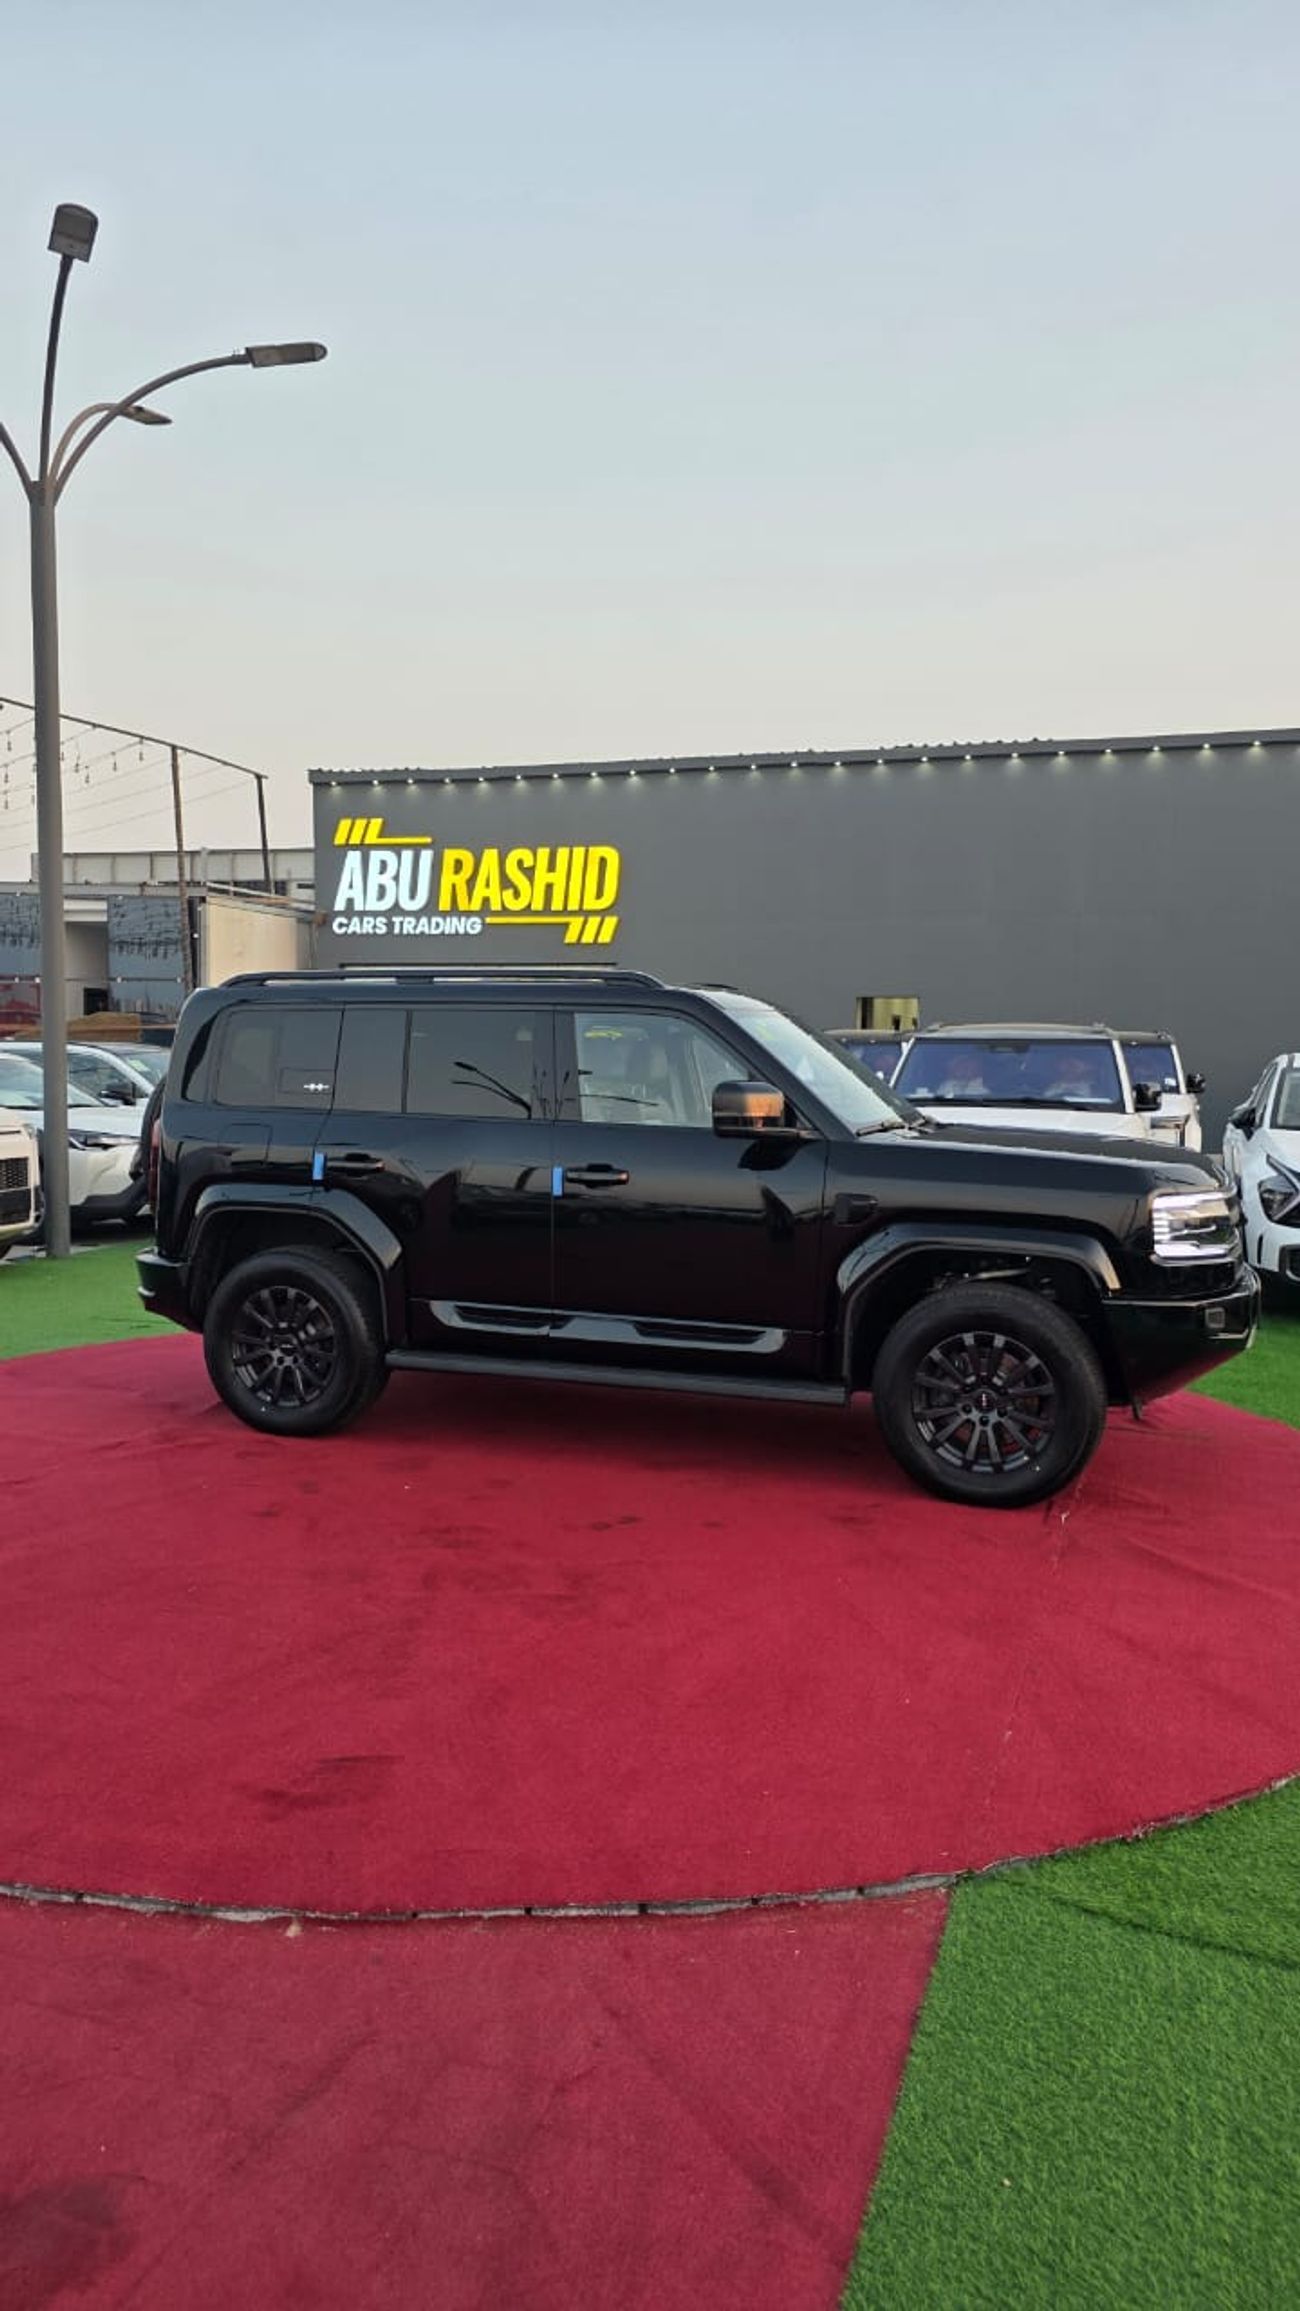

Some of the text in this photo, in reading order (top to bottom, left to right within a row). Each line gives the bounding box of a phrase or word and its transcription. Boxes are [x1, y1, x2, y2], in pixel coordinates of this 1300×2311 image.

[333, 846, 620, 912] ABU RASHID
[332, 916, 482, 935] CARS TRADING
